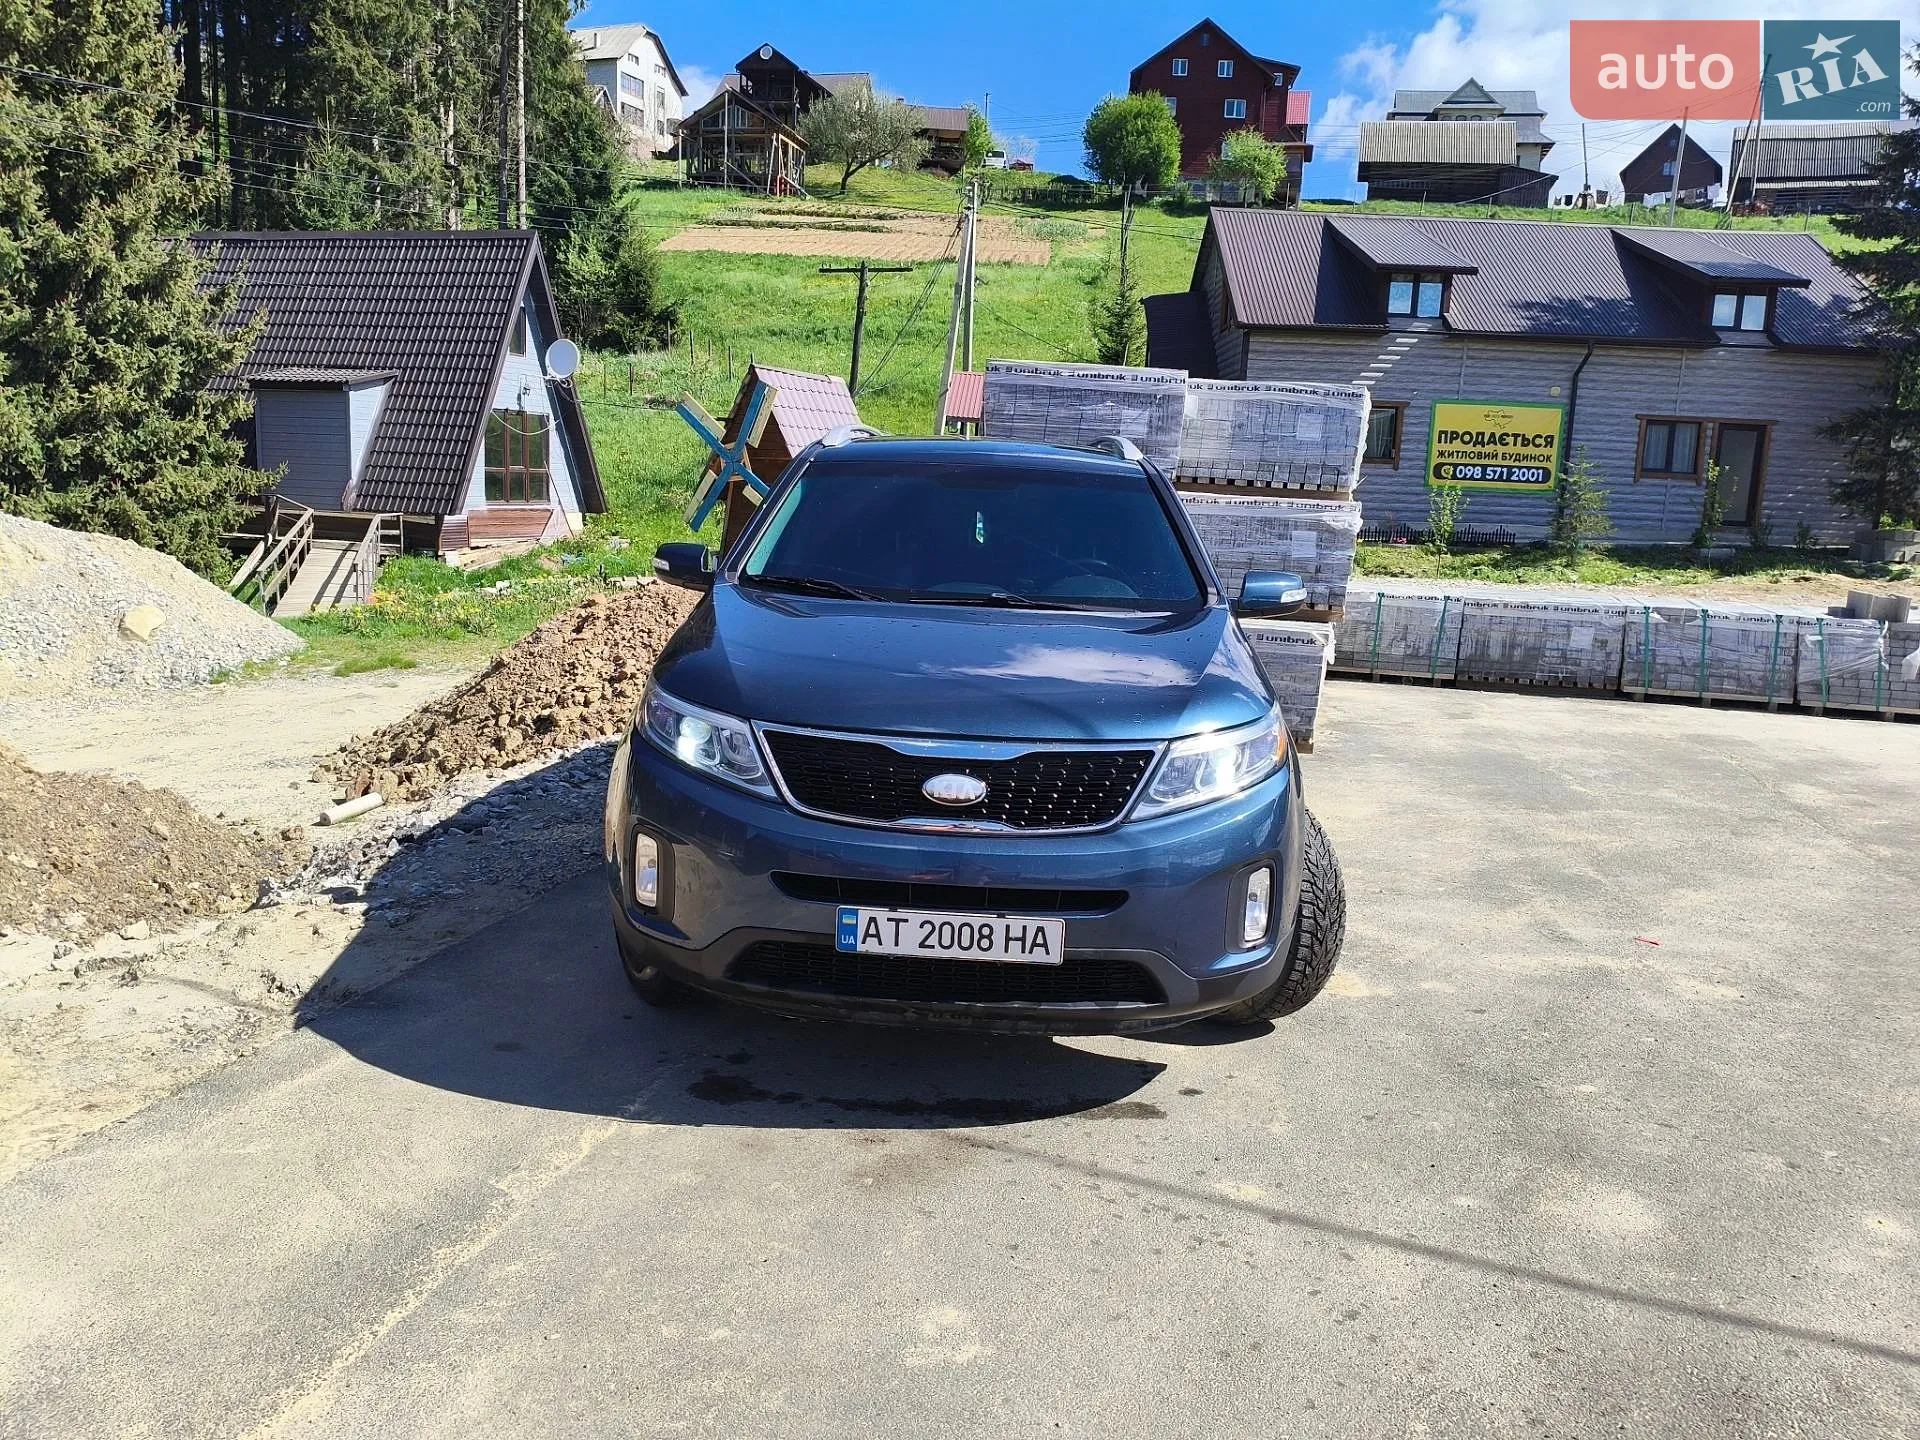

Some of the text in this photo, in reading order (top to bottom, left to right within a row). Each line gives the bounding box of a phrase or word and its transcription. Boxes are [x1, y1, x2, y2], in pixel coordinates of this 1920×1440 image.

[1074, 371, 1127, 382] unibruk
[1437, 430, 1555, 448] ПРОДАЄТЬСЯ
[1437, 449, 1553, 463] ЖИТЛОВИЙ БУДИНОК
[1456, 466, 1543, 481] 098 571 2001
[1266, 636, 1317, 646] unibruk
[841, 935, 856, 945] UA
[861, 916, 1051, 956] AT 2008 HA
